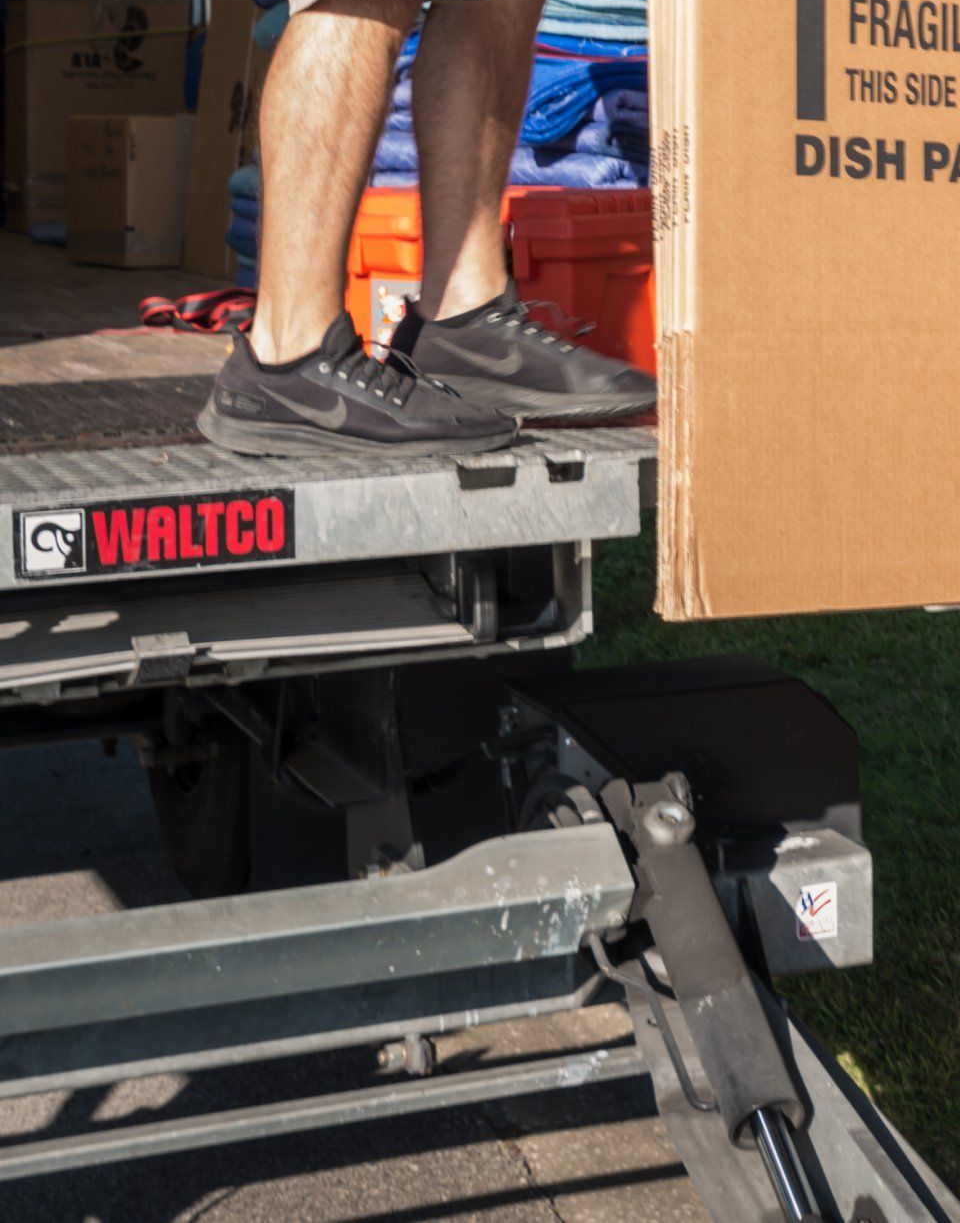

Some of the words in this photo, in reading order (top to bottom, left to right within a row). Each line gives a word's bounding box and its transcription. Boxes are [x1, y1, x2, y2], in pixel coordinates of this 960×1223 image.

[845, 67, 898, 105] THIS
[905, 73, 957, 108] SIDE
[795, 134, 907, 180] DISH
[91, 496, 286, 566] WALTCO
